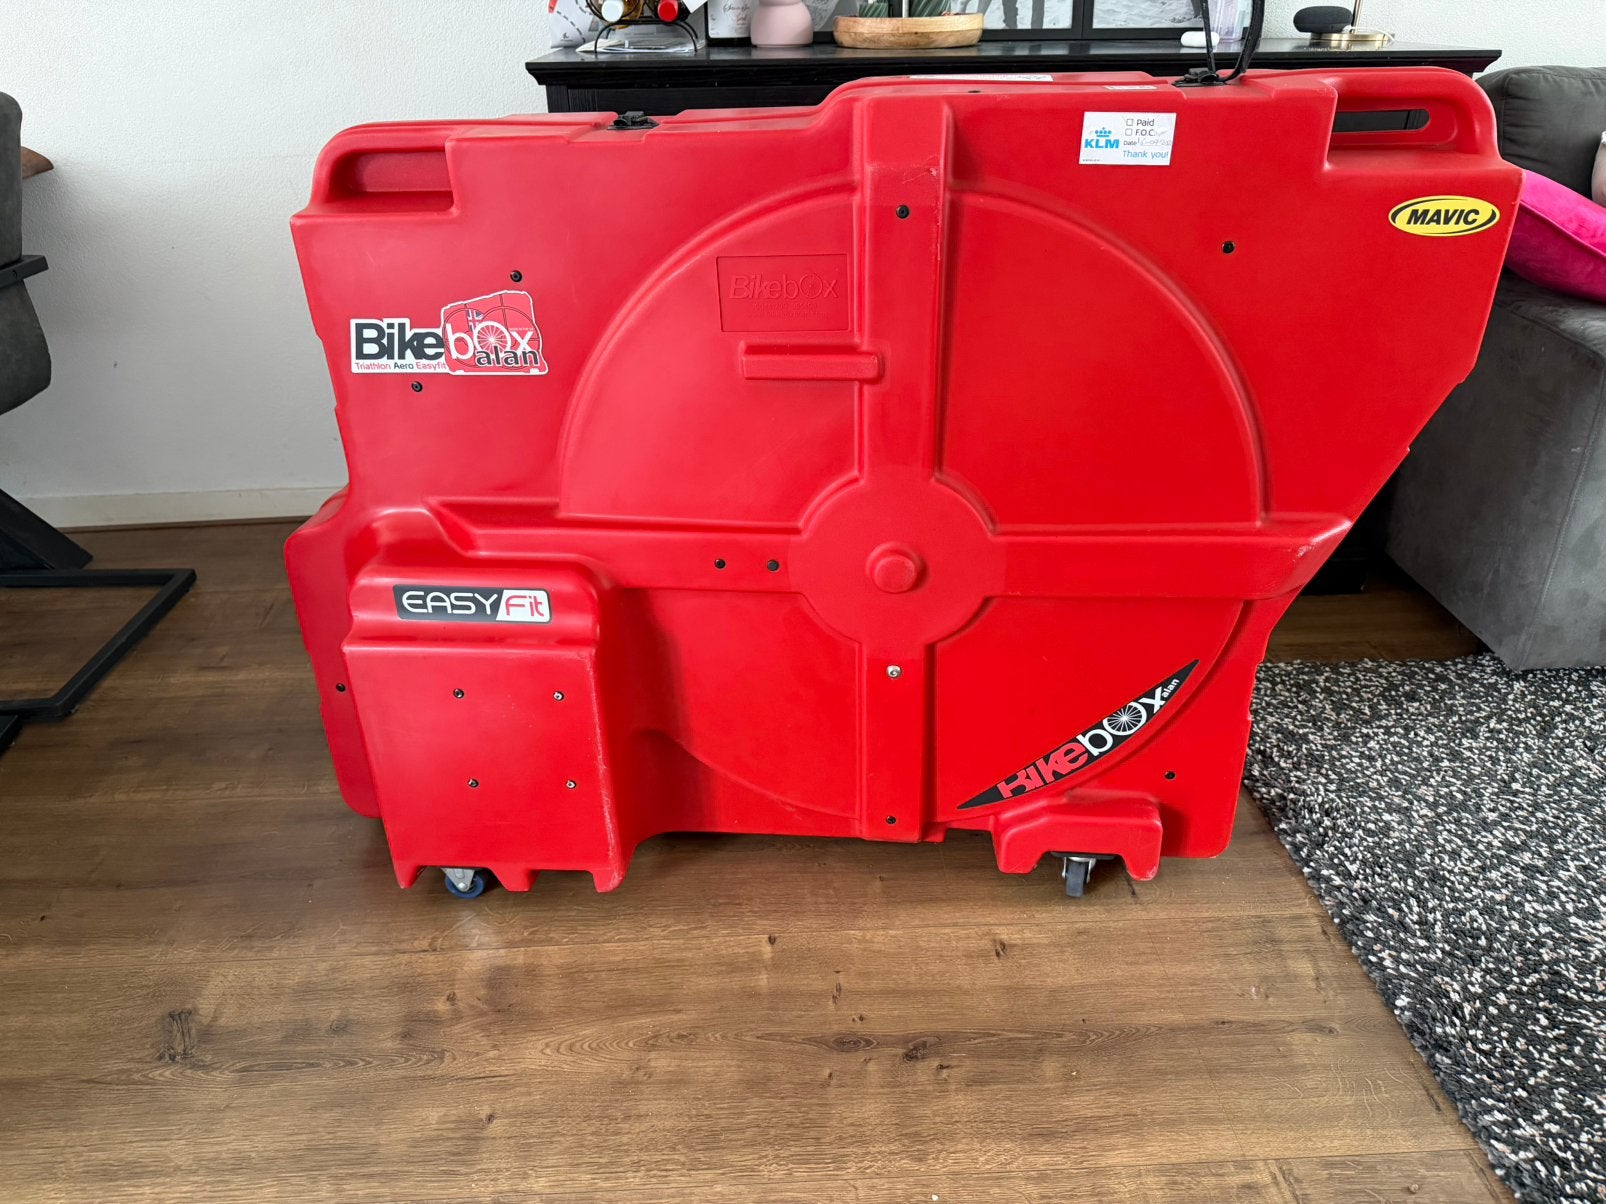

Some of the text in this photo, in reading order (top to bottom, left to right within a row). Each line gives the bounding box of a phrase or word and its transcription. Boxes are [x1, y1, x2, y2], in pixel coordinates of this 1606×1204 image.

[1136, 118, 1155, 127] Paid
[1084, 138, 1120, 149] KLM
[1122, 150, 1169, 160] Thank you!
[1406, 208, 1480, 225] MAVIC
[476, 345, 540, 367] alan
[354, 361, 447, 372] Triathlon Aero Easyfit
[1161, 678, 1180, 698] alan
